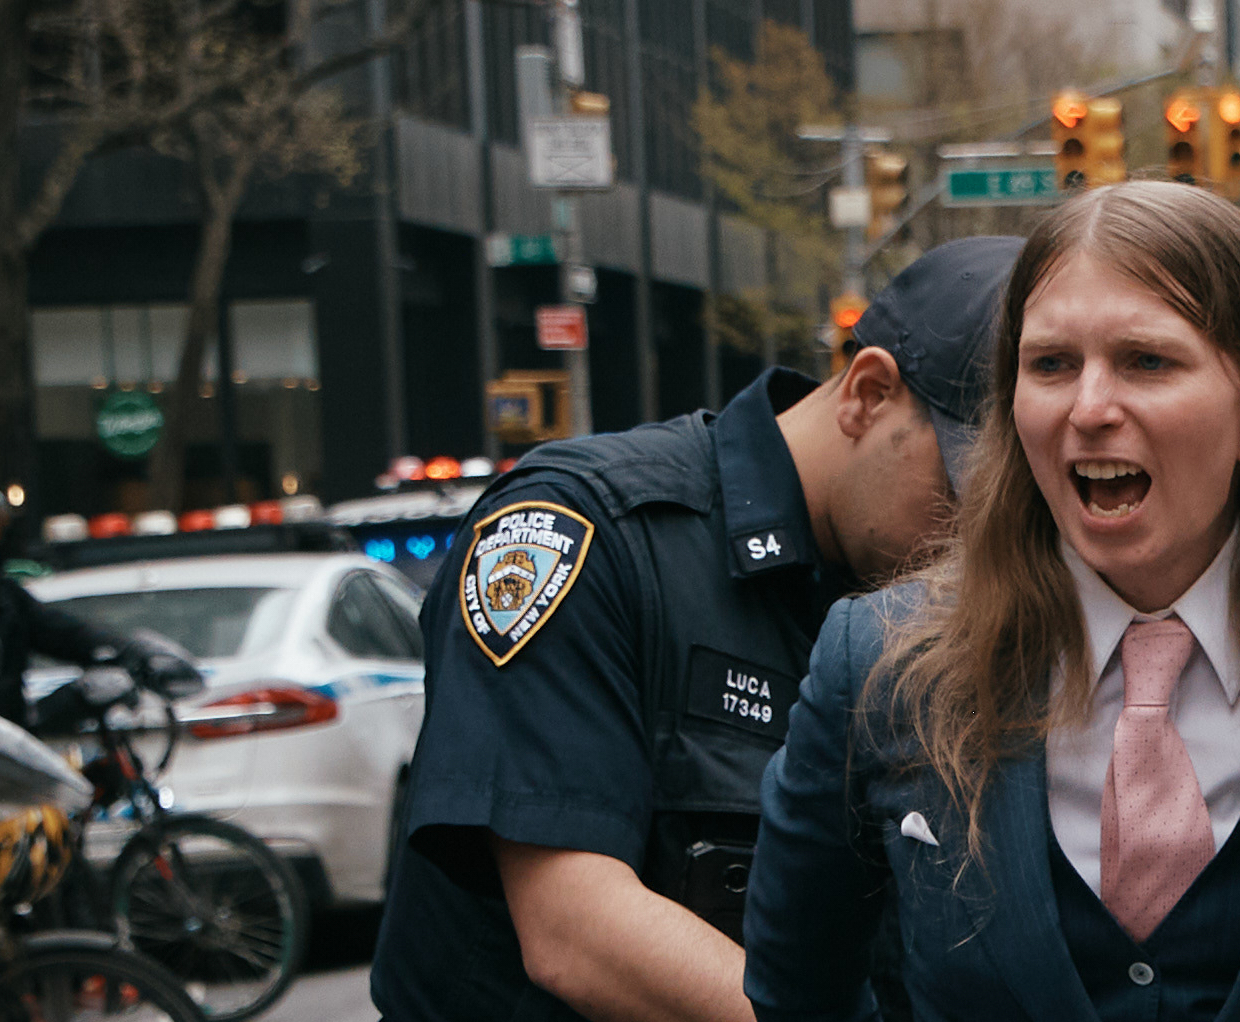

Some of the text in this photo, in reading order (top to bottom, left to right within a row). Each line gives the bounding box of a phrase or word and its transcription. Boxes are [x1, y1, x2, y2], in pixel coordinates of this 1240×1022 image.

[497, 511, 557, 534] POLICE
[474, 528, 575, 558] DEPARTMENT
[747, 533, 782, 560] S4
[465, 573, 492, 636] CITY OF
[508, 562, 573, 643] NEW YORK
[726, 668, 771, 700] LUCA
[722, 692, 773, 723] 17349
